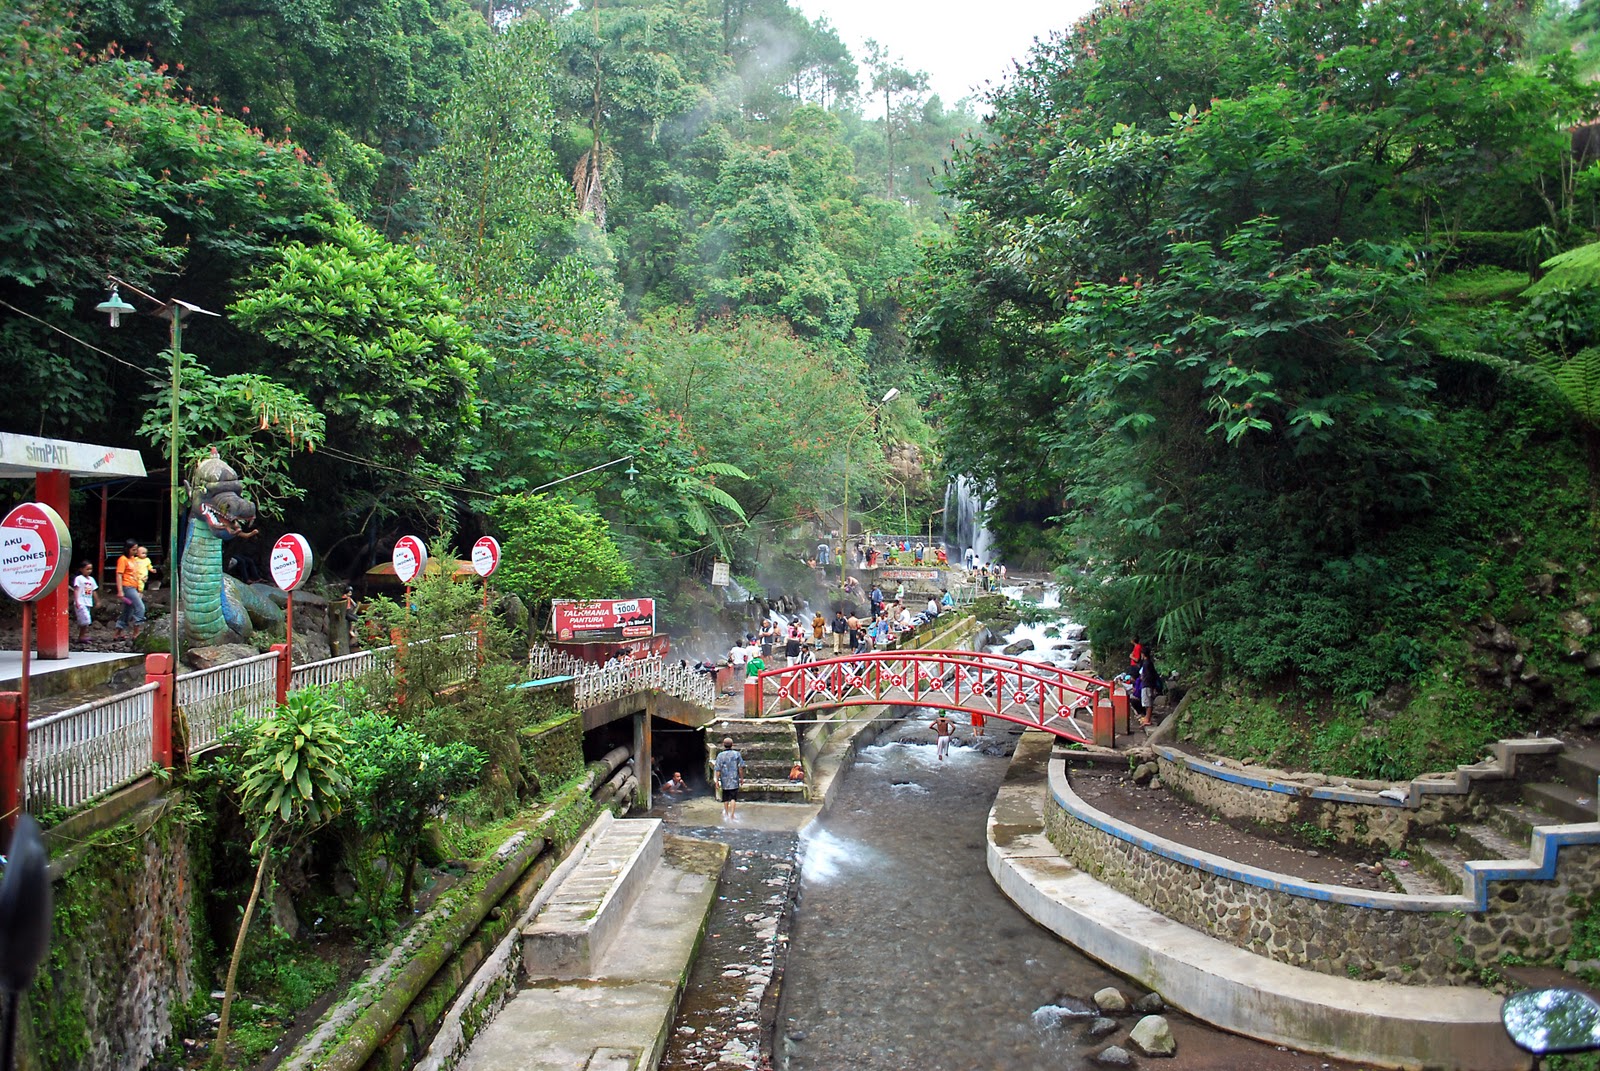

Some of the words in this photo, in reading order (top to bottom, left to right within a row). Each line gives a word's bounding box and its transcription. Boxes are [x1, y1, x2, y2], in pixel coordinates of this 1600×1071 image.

[26, 442, 69, 465] simPATI
[4, 537, 23, 547] AKU
[3, 550, 53, 565] INDONESIA
[563, 609, 610, 617] TALKMANIA
[618, 604, 636, 613] 1000
[569, 616, 604, 624] PANTURA
